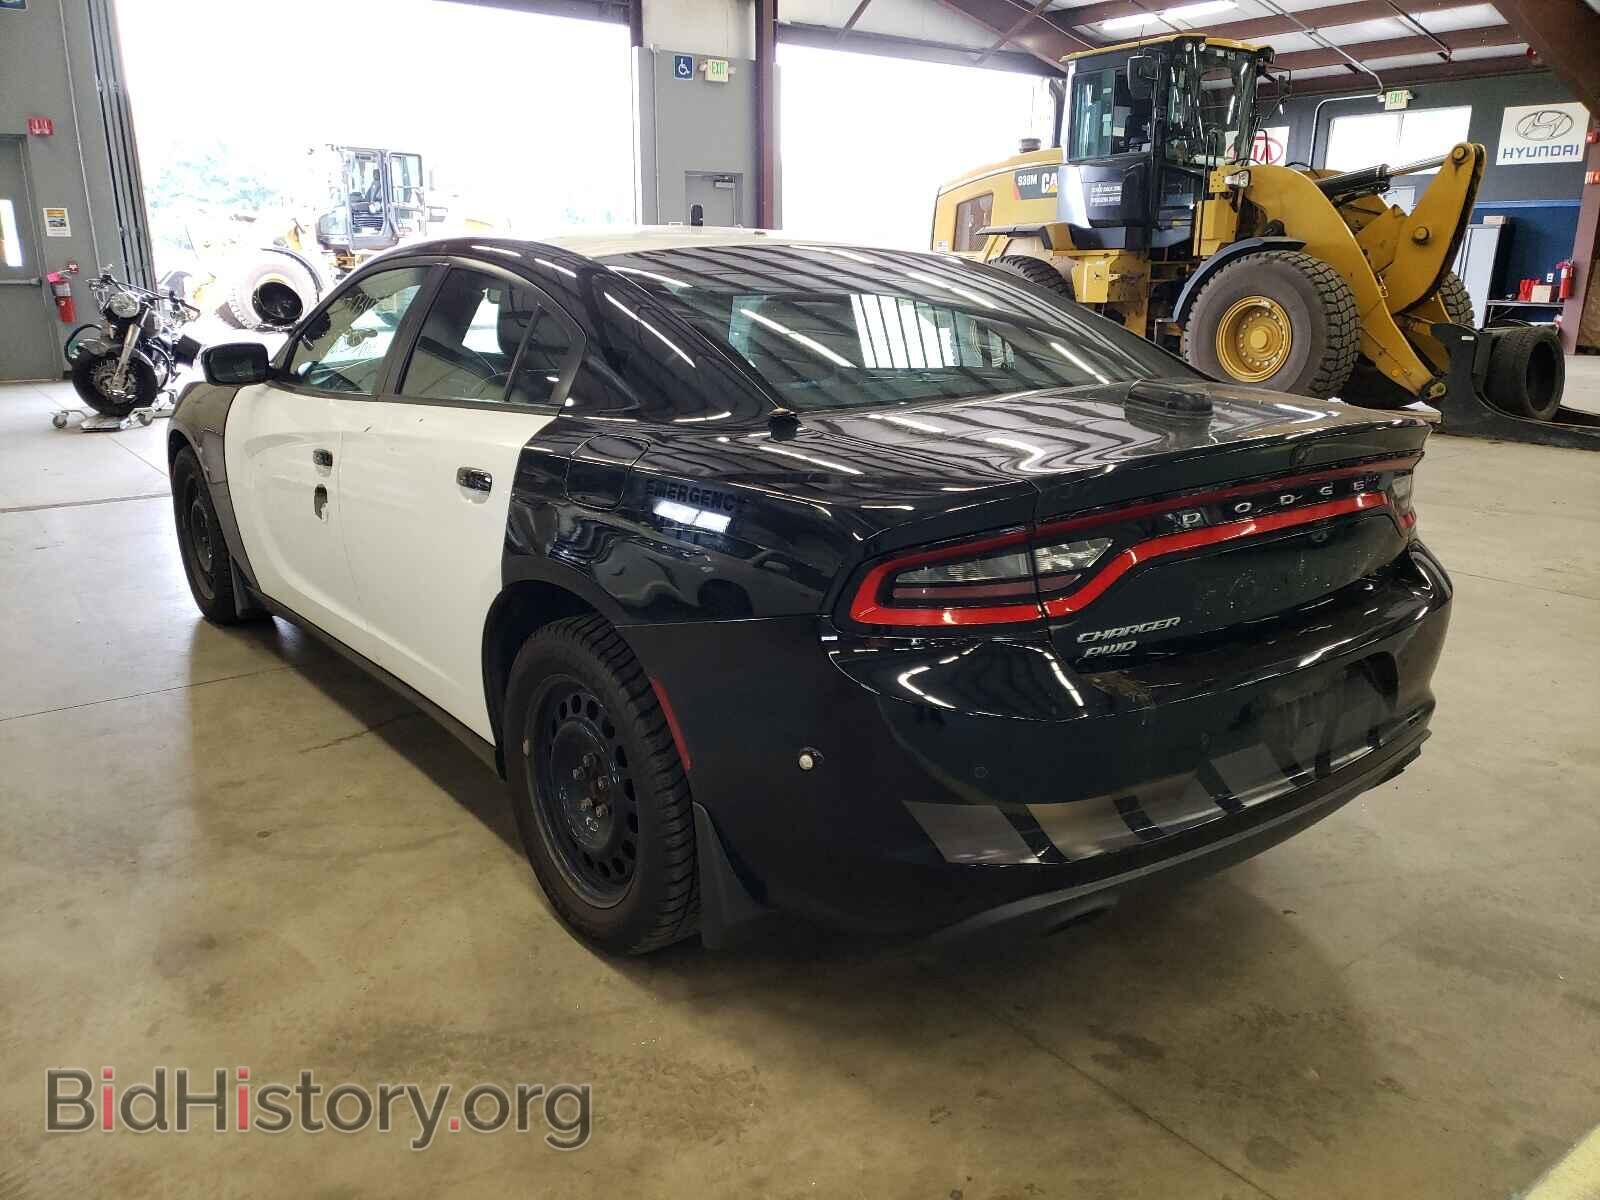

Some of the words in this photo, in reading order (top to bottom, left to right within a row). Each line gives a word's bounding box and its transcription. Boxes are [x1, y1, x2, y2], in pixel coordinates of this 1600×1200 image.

[711, 61, 726, 75] EXIT
[1389, 92, 1405, 104] EXIT
[1503, 144, 1580, 159] HYUNDAI
[1017, 174, 1038, 186] 938M
[1041, 172, 1058, 194] CA
[645, 480, 745, 512] EMERGENC
[1182, 480, 1366, 528] DODGE
[1077, 616, 1181, 643] CHARGER
[1083, 640, 1137, 658] AWD
